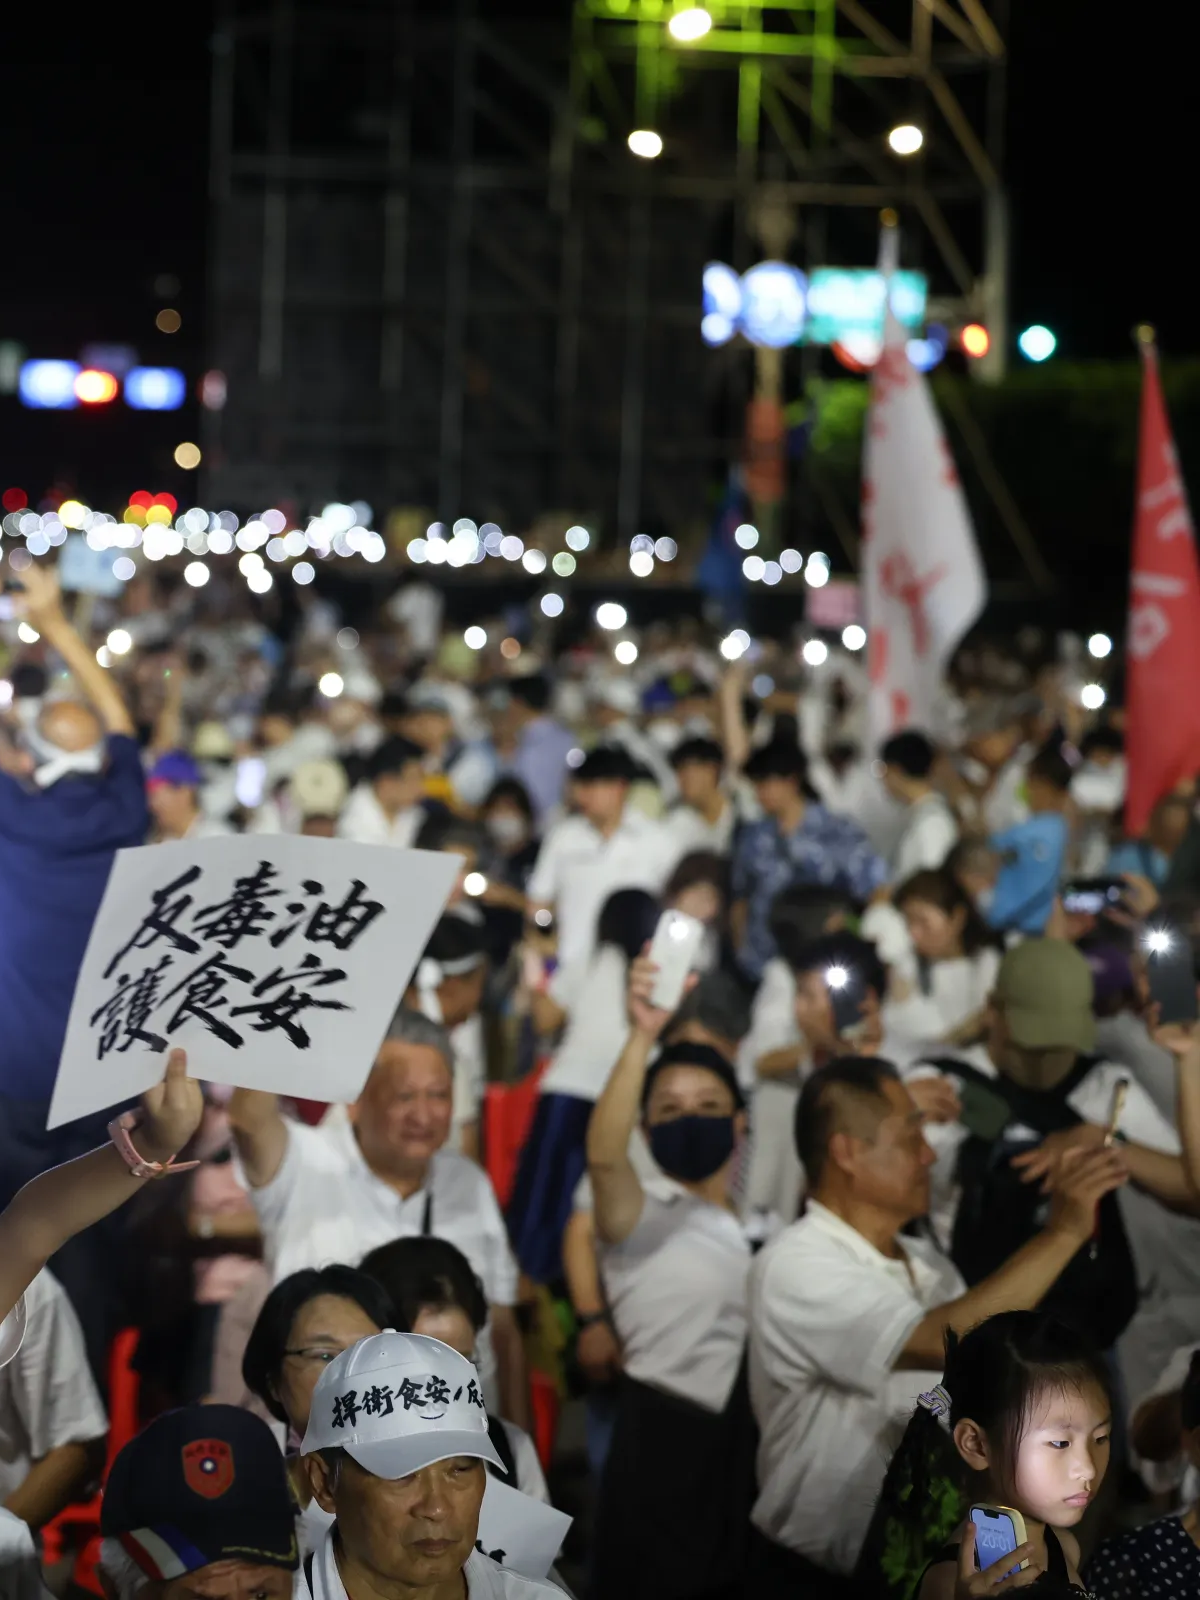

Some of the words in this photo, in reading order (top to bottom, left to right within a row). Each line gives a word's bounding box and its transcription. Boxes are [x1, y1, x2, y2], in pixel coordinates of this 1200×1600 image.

[103, 860, 385, 978] 反毒油
[90, 952, 351, 1060] 護食安
[331, 1375, 485, 1428] 捍衛食安/反
